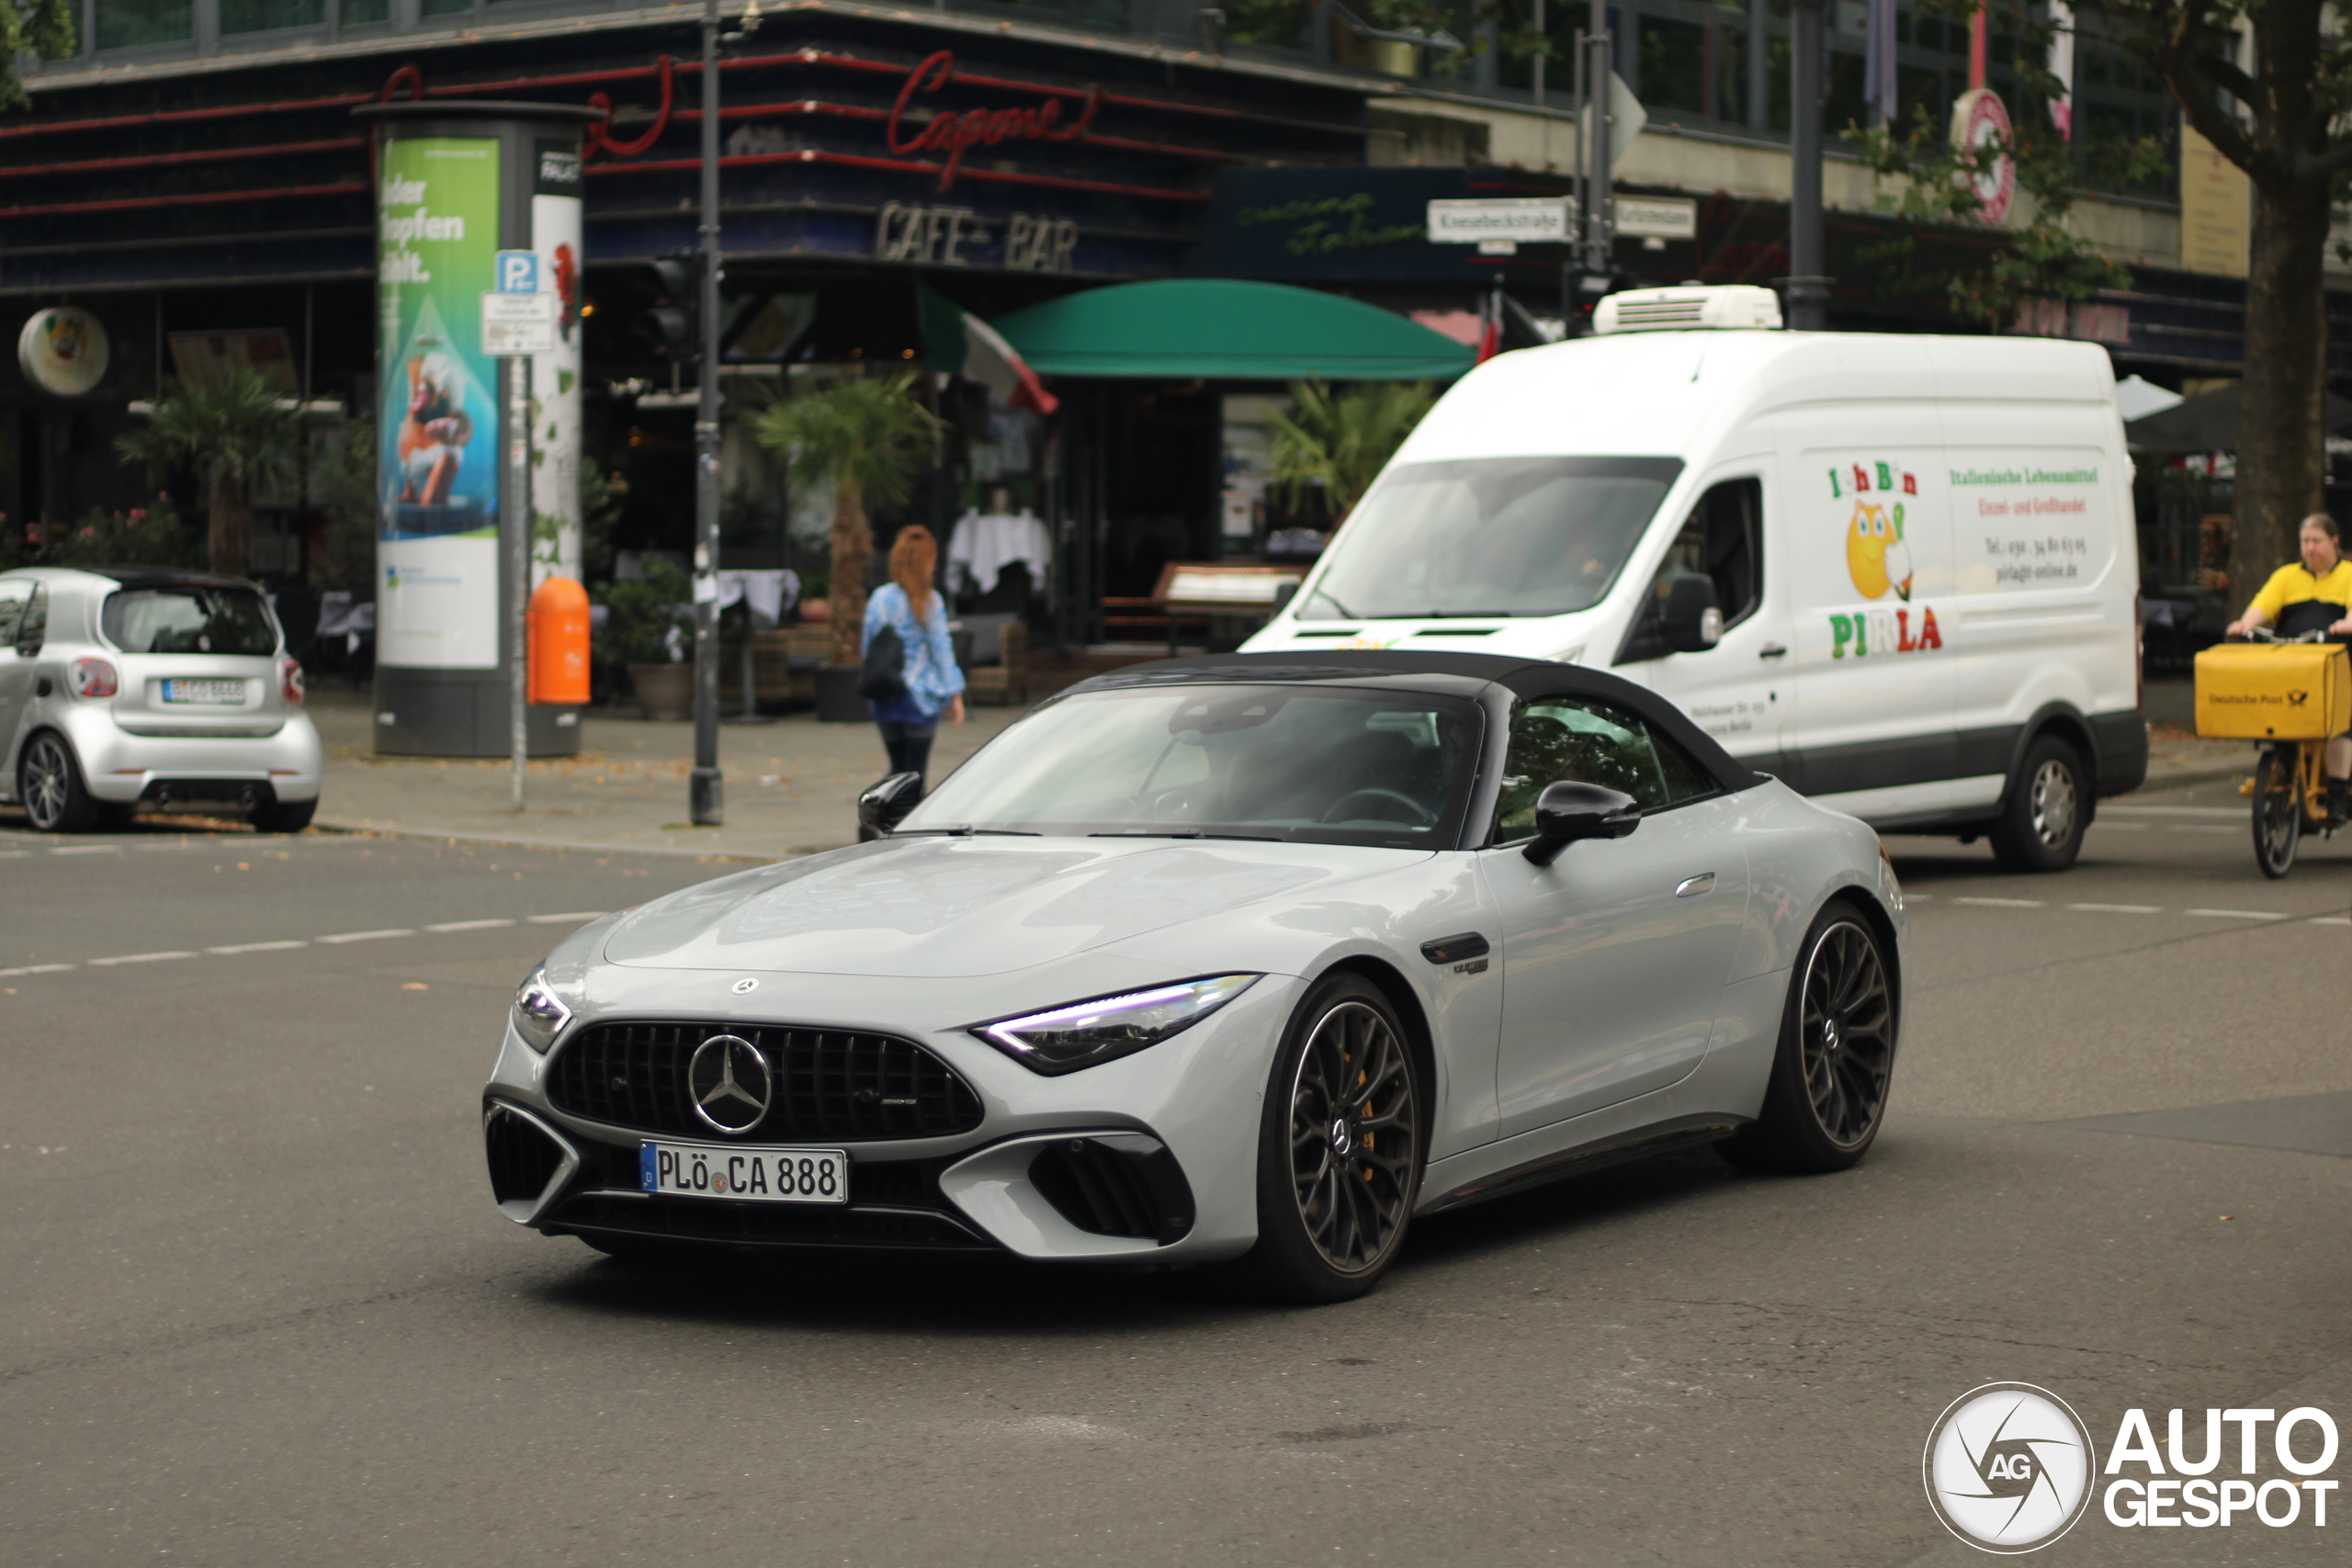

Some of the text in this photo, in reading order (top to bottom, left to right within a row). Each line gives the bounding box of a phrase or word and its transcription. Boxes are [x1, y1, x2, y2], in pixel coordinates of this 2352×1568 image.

[888, 50, 1100, 196] Capone
[1005, 212, 1080, 272] BAR
[1828, 460, 1917, 499] Ich Bin
[1950, 467, 2098, 485] Italienische Lebensmittel
[2014, 498, 2031, 514] und
[1829, 605, 1943, 660] PIRLA
[2209, 693, 2283, 705] Deutsche Post
[729, 1156, 768, 1194] CA
[777, 1157, 837, 1195] 888
